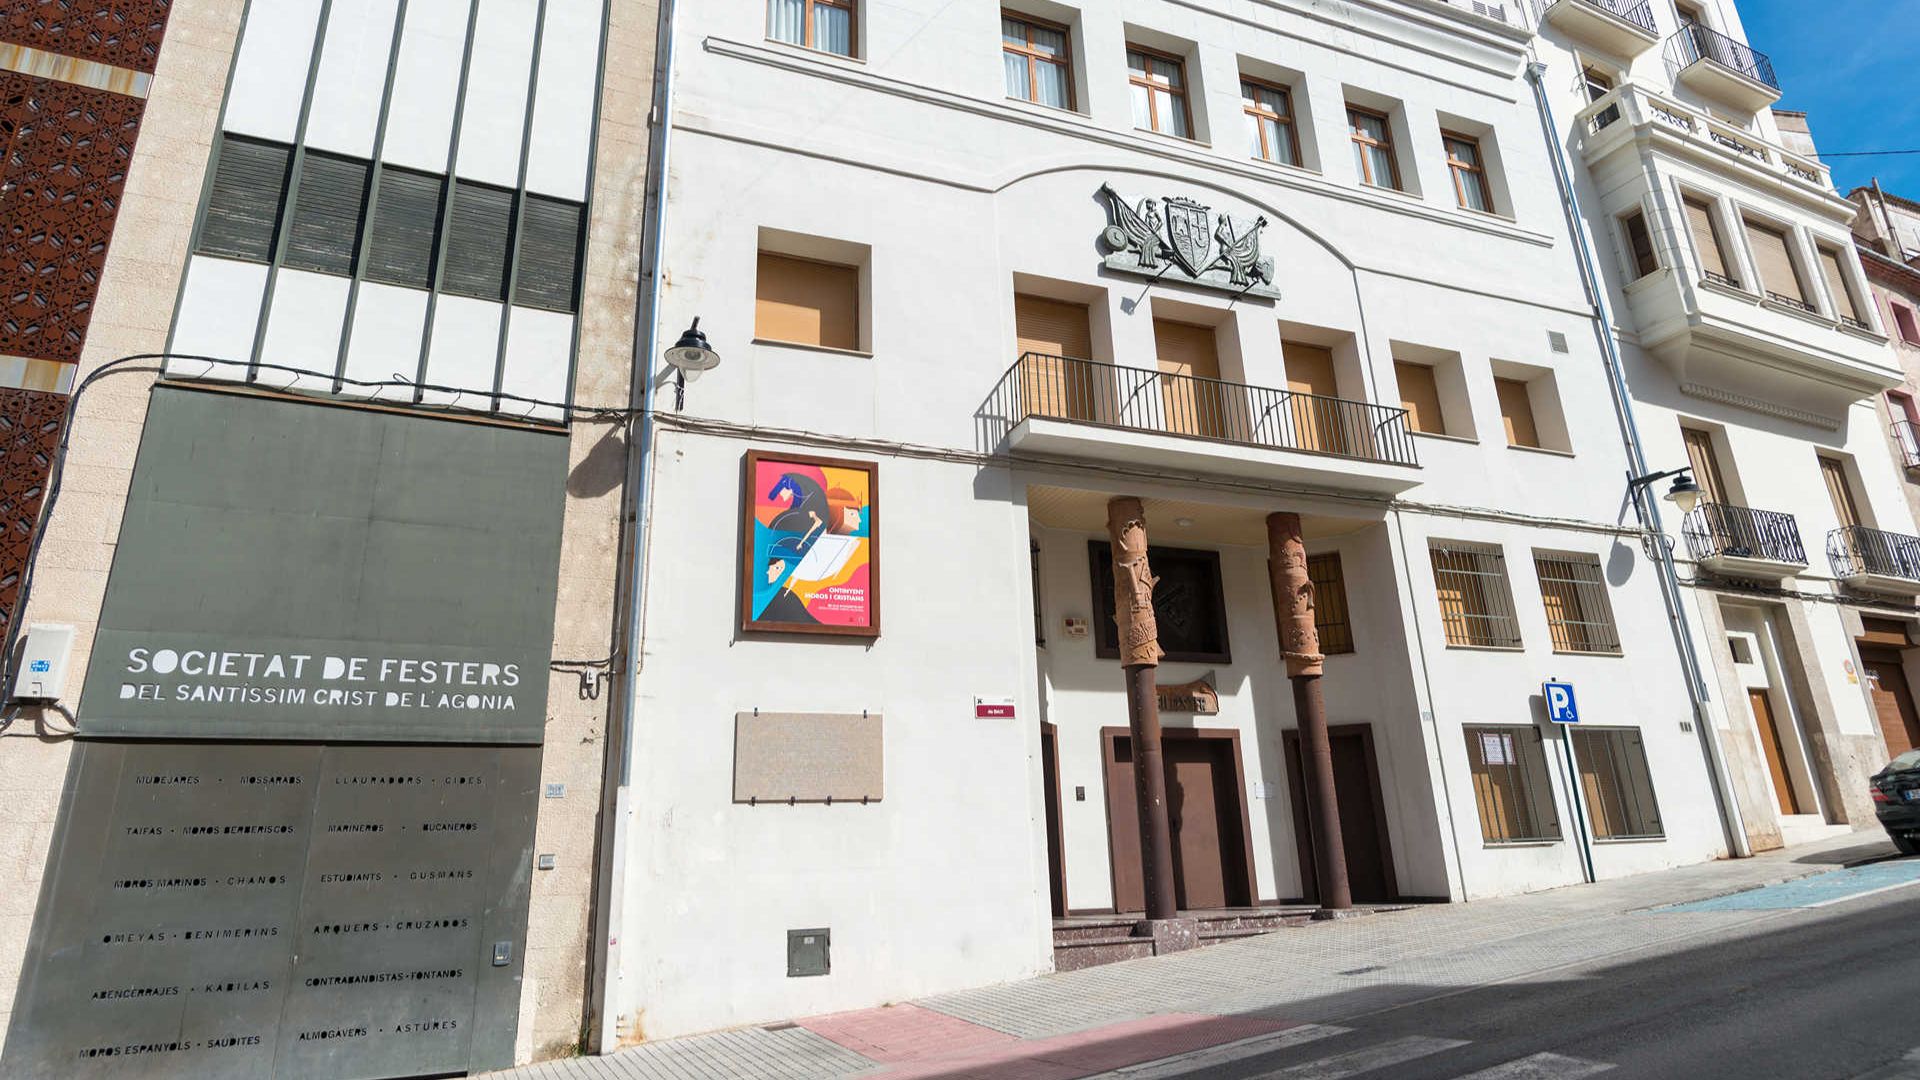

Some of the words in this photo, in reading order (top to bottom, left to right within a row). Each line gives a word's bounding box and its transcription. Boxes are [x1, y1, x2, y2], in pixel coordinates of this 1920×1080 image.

[127, 648, 312, 679] SOCIETAT
[323, 657, 368, 681] DE
[380, 660, 520, 687] FESTERS
[120, 685, 165, 701] DEL
[176, 682, 306, 705] SANTÍSSIM
[314, 689, 378, 706] CRIST
[386, 692, 413, 708] DE
[1549, 686, 1569, 719] P
[240, 775, 302, 785] MOSSARABS
[335, 776, 422, 785] LLAURADORS
[444, 776, 482, 785] CIDES
[126, 826, 163, 836] TAIFAS
[182, 825, 220, 835] MOROS
[327, 824, 384, 833] MARINEROS
[422, 822, 478, 832] BUCANEROS
[113, 879, 154, 889] MOROS
[156, 877, 207, 888] MARINOS
[227, 875, 286, 886] CHANOS
[320, 872, 382, 883] ESTUDIANTS
[410, 870, 473, 880] GUSMANS
[313, 922, 379, 935] ARQUERS
[396, 918, 468, 931] CRUZADOS
[102, 932, 165, 944] OMEYAS
[184, 926, 278, 940] BENIMERINS
[91, 985, 179, 1000] ABENCERRAJES
[204, 980, 270, 993] KABILAS
[395, 1020, 457, 1034] ASTURES
[78, 1046, 121, 1058] MOROS
[124, 1040, 191, 1055] ESPANYOLS
[207, 1035, 261, 1049] SAUDITES
